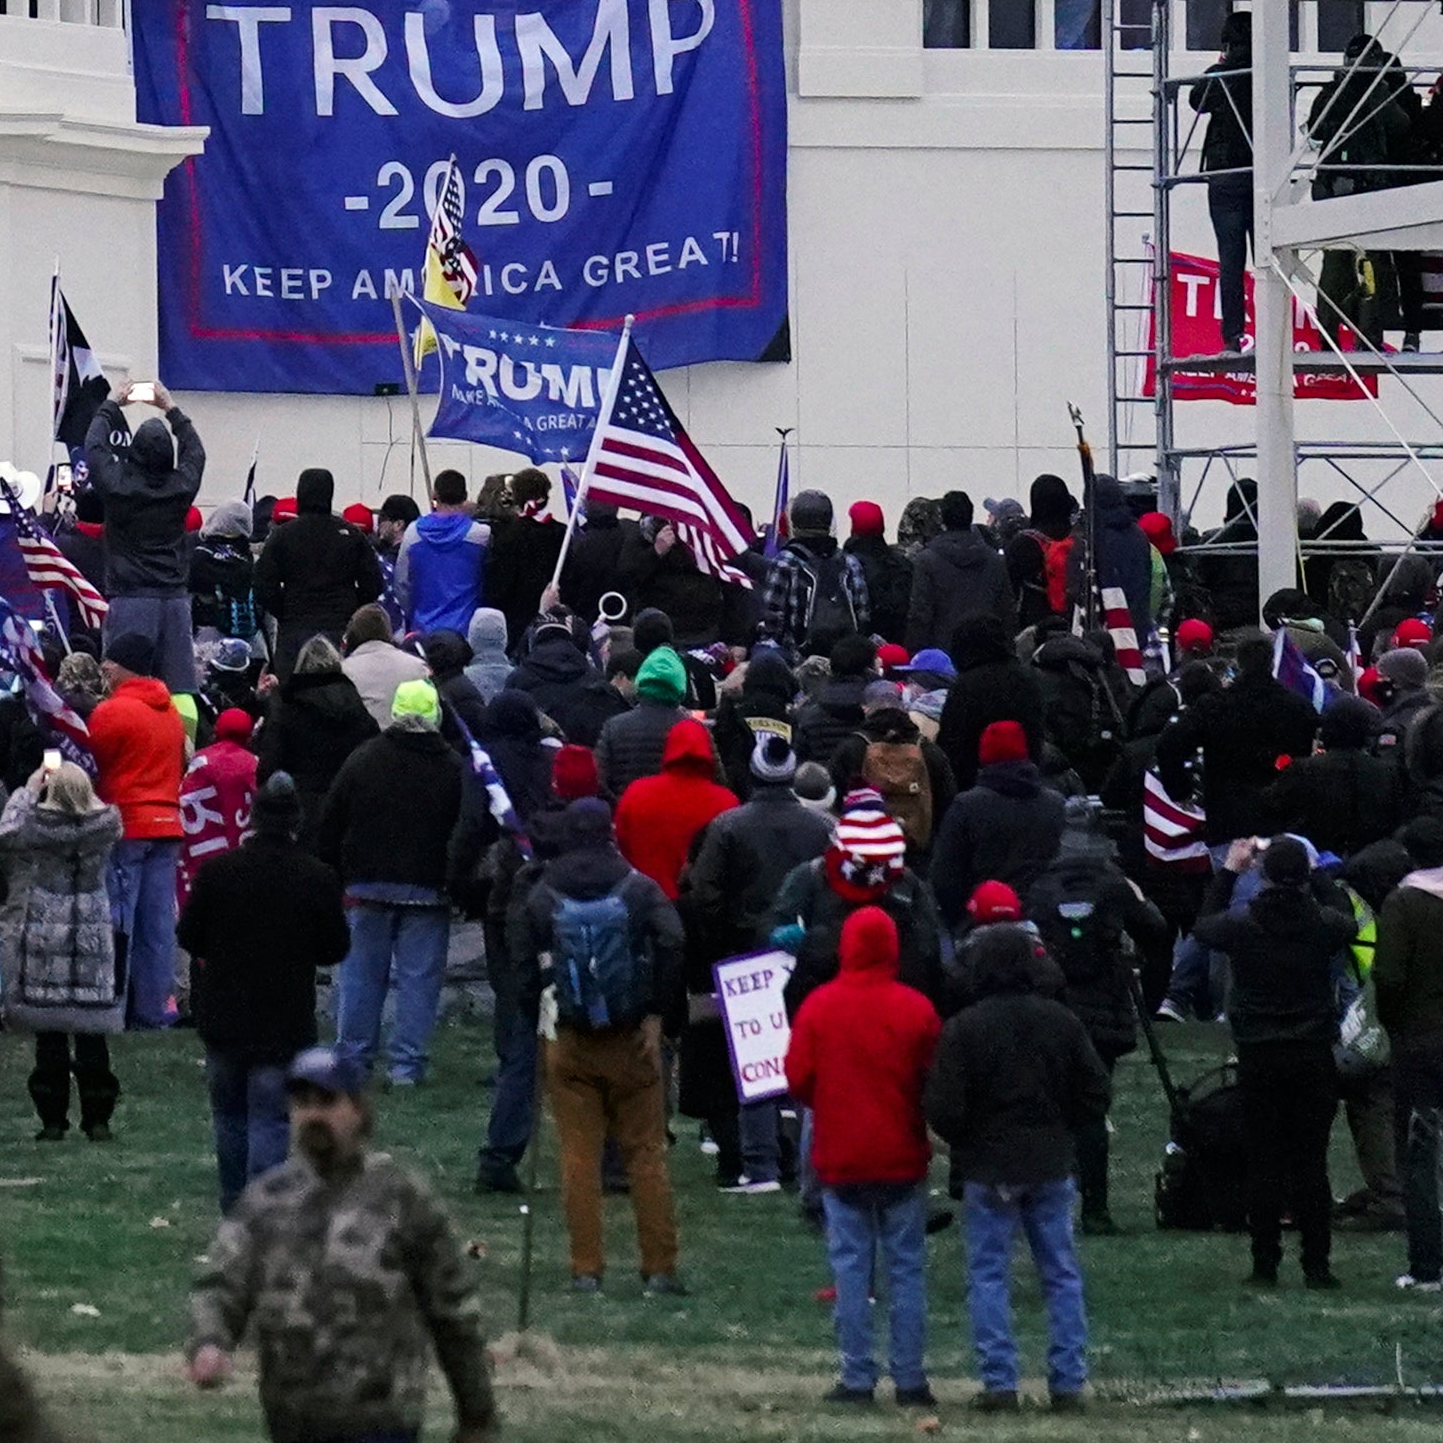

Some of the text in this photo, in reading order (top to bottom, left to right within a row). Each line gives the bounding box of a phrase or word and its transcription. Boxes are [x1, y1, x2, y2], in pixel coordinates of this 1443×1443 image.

[223, 231, 739, 300] KEEP AMICA GREAT!
[536, 413, 586, 432] GREAT
[723, 969, 774, 997] KEEP
[734, 1012, 784, 1040] TO U
[741, 1057, 781, 1083] CON
